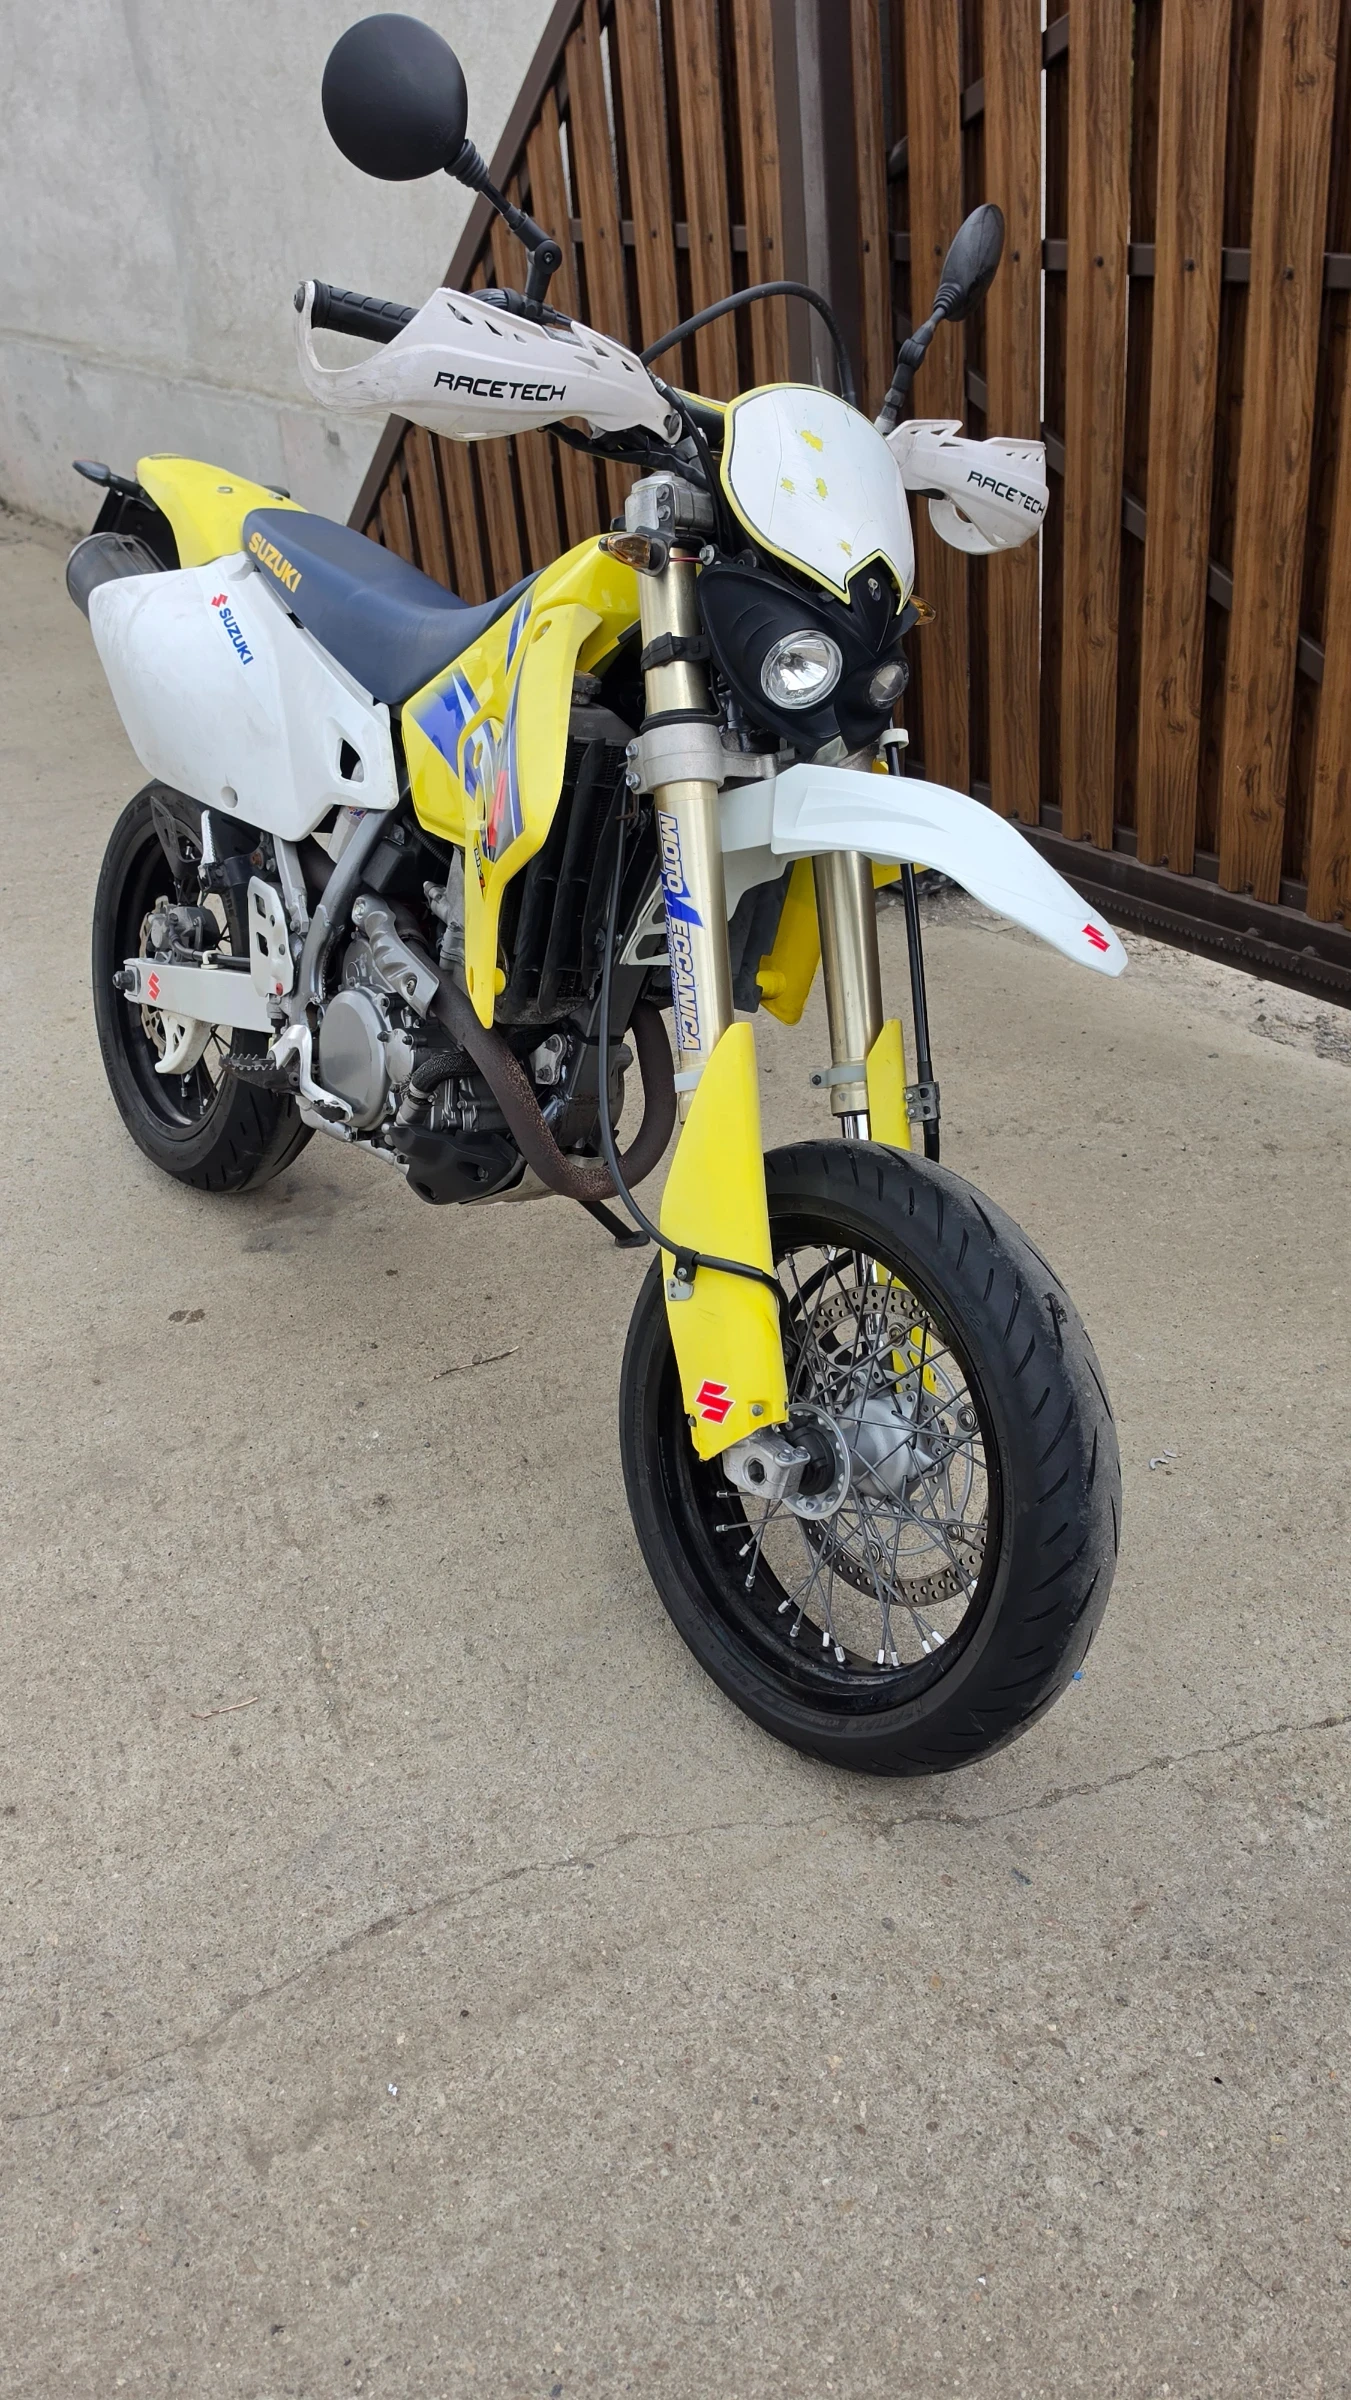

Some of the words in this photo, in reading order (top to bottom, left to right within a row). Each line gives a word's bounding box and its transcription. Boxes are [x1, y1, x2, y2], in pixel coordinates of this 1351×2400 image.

[433, 371, 567, 402] RACETECH
[966, 470, 1046, 517] RACETECH
[249, 532, 303, 593] SUZUKI
[219, 607, 254, 665] SUZUKI
